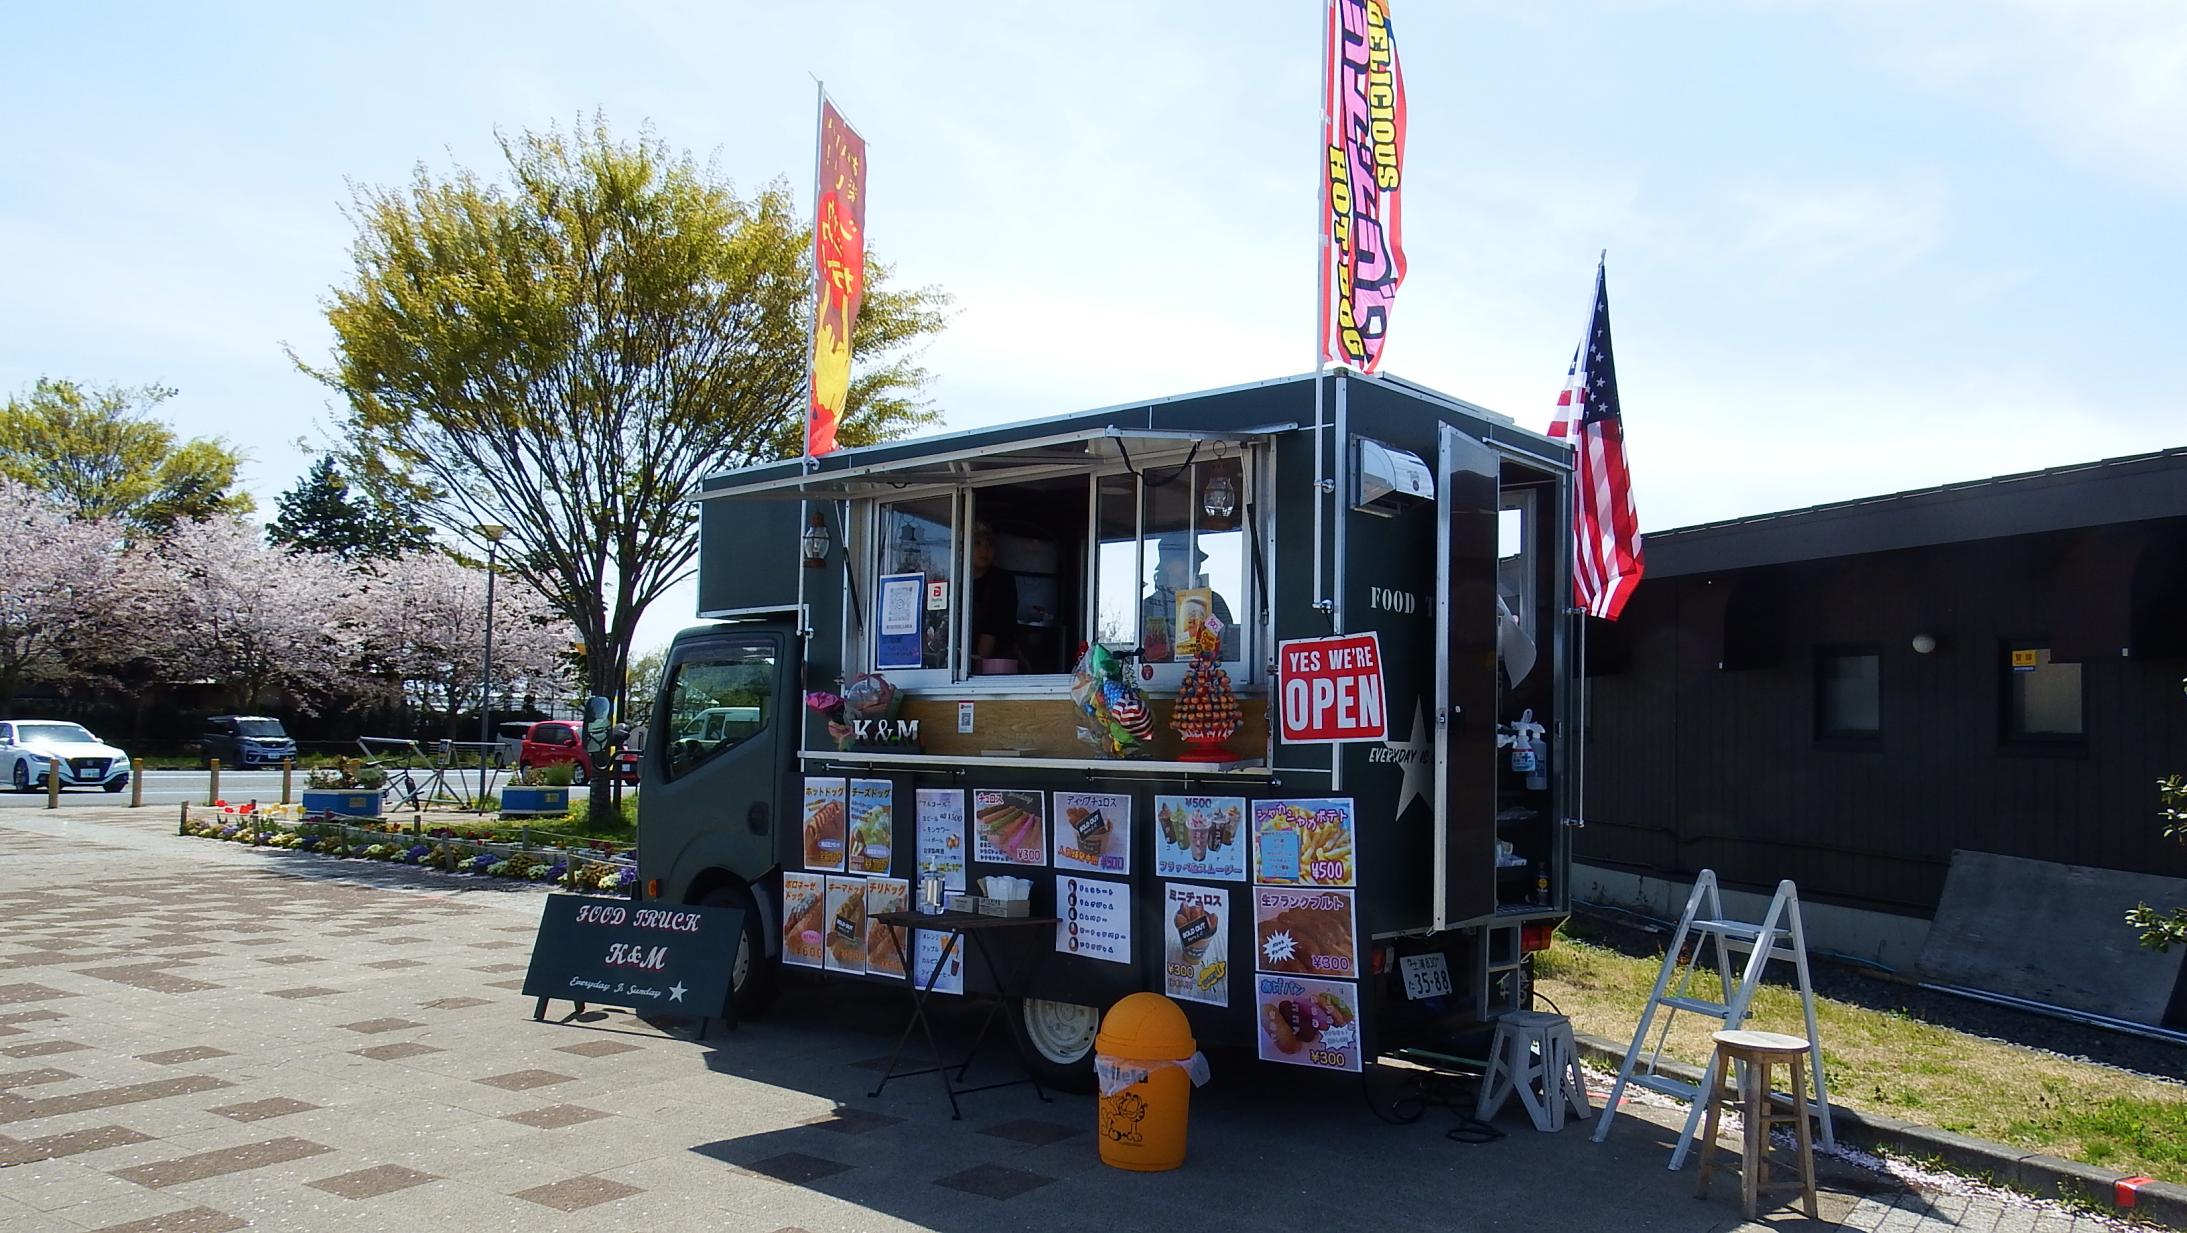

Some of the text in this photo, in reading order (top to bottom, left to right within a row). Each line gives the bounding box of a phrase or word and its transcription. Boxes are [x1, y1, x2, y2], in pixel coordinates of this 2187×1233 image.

[1366, 0, 1399, 191] DELICIOUS
[1329, 145, 1366, 359] HOT DOG
[1370, 586, 1415, 614] FOOD
[1289, 646, 1374, 672] YES WE'RE
[1285, 673, 1381, 731] OPEN
[1369, 747, 1417, 764] EVERYDAY
[805, 787, 845, 798] ホットドッグ
[851, 787, 892, 798] チーズドッグ
[978, 793, 1004, 804] チュロス
[1185, 797, 1212, 809] ¥500
[1017, 848, 1041, 861] ¥300
[1311, 861, 1344, 880] ¥500
[869, 883, 906, 896] チリドッグ
[1169, 889, 1222, 907] ミニチュロス
[1261, 893, 1344, 911] 生フランクフルト
[576, 904, 701, 932] FOOD TRUCK
[1182, 927, 1195, 939] SOLD
[1194, 922, 1206, 933] OUT
[605, 943, 669, 971] K&M
[1312, 955, 1349, 971] ¥300
[1167, 962, 1195, 977] ¥300
[569, 976, 611, 992] Everyday
[626, 984, 663, 999] Sunday
[1309, 1049, 1345, 1067] ¥300
